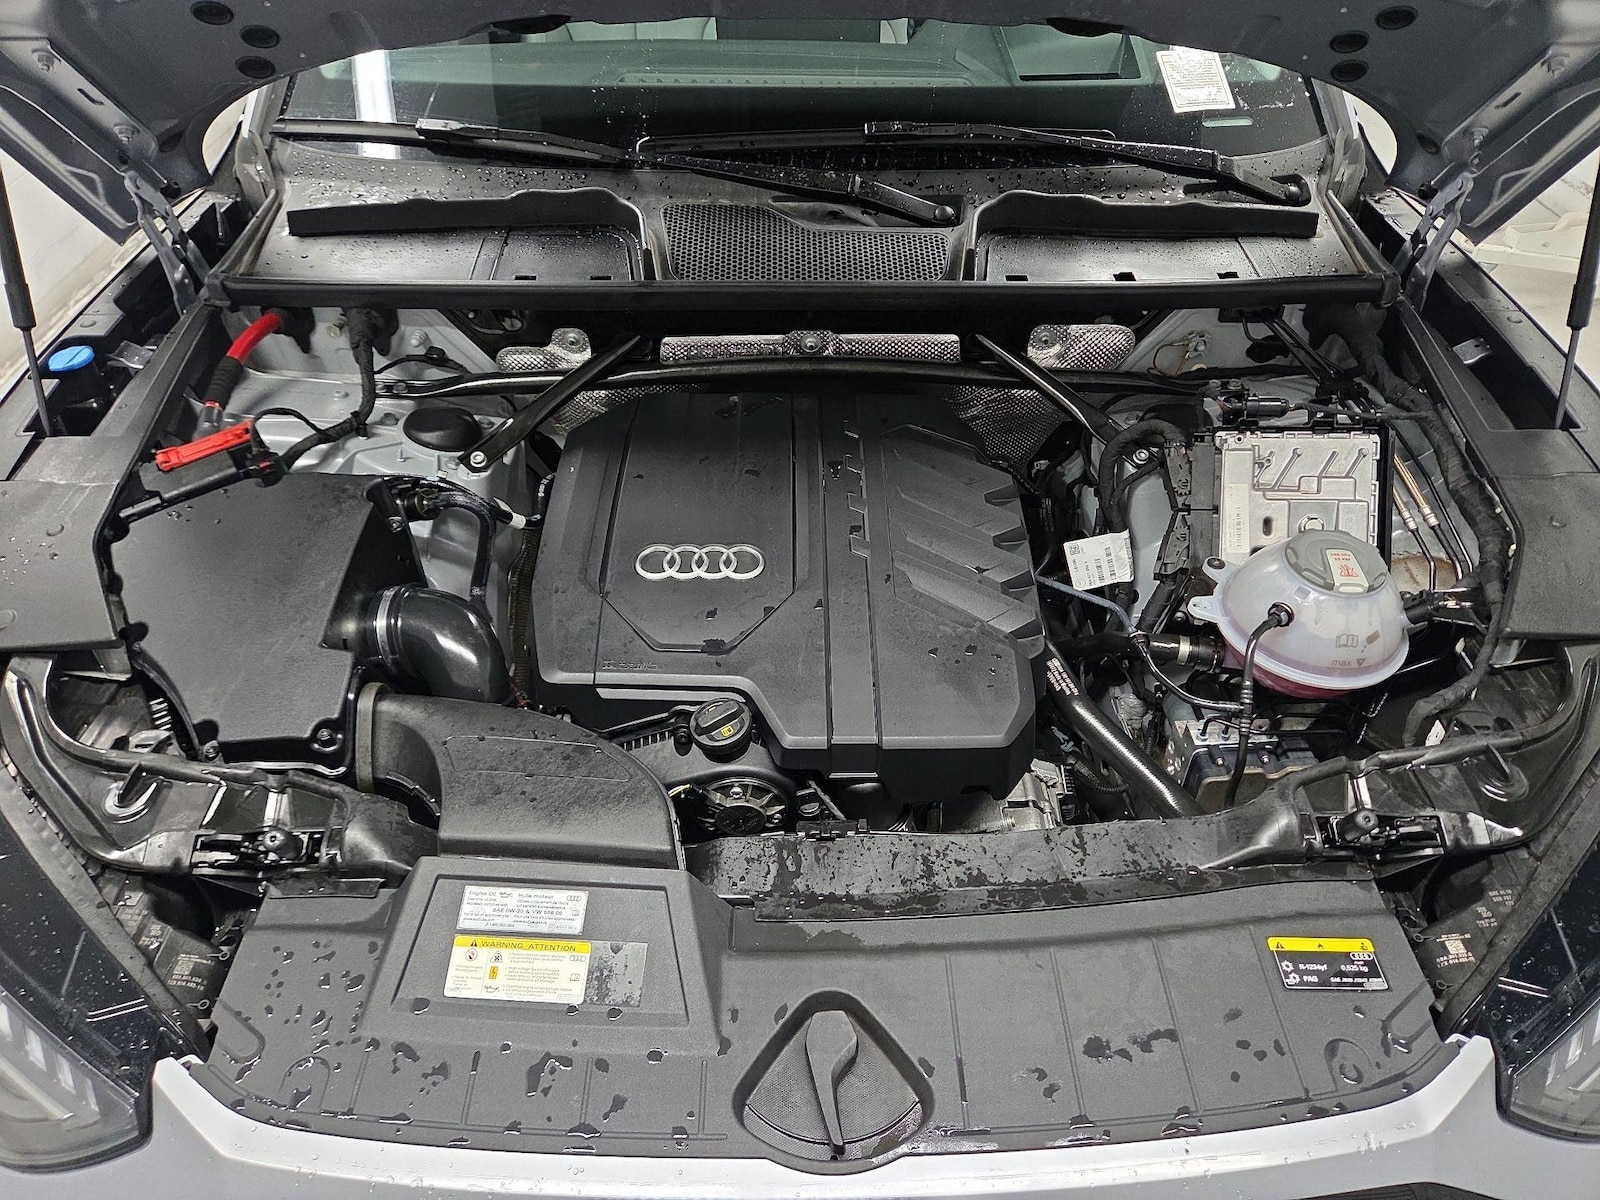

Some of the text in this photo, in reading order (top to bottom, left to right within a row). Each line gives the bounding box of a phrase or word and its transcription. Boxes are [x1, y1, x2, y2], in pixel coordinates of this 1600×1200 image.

[1331, 659, 1352, 667] max
[481, 940, 577, 952] WARNING ATTENTION
[1299, 963, 1327, 971] R-1234yf
[1359, 965, 1369, 973] kg
[1303, 975, 1319, 983] PAG
